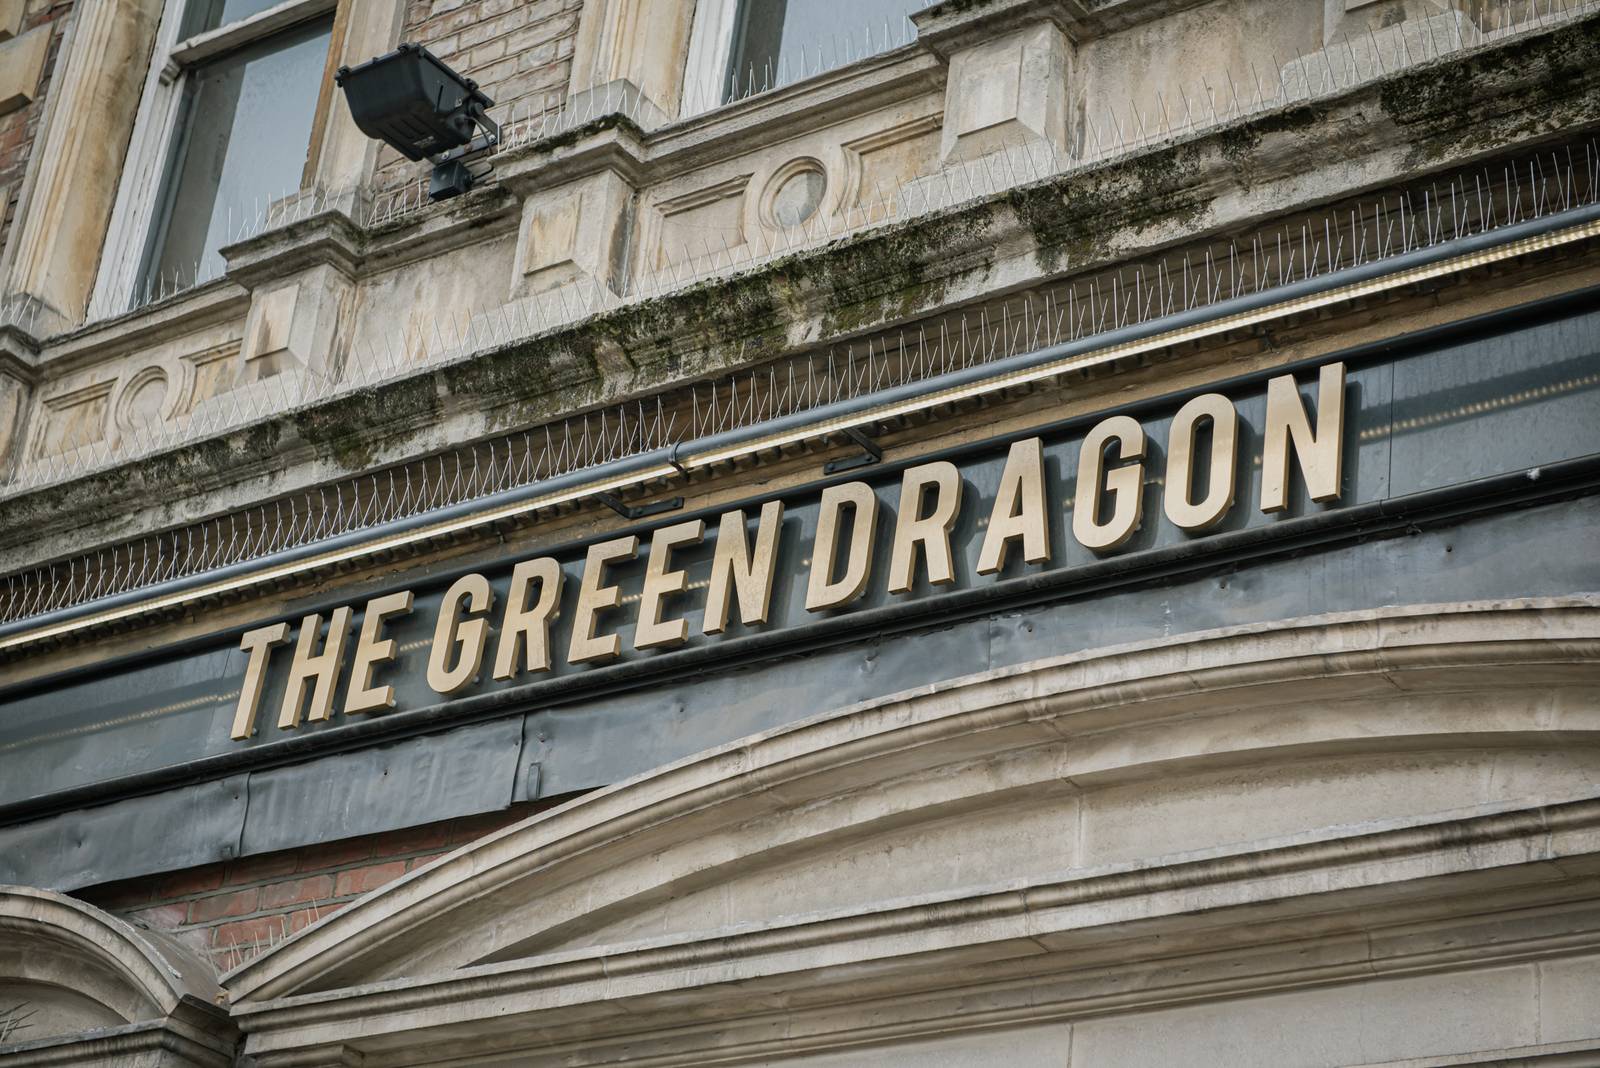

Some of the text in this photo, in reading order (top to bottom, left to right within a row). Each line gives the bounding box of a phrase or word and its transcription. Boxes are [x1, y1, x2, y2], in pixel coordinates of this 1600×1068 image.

[231, 361, 1346, 740] THE GREEN DRAGON
